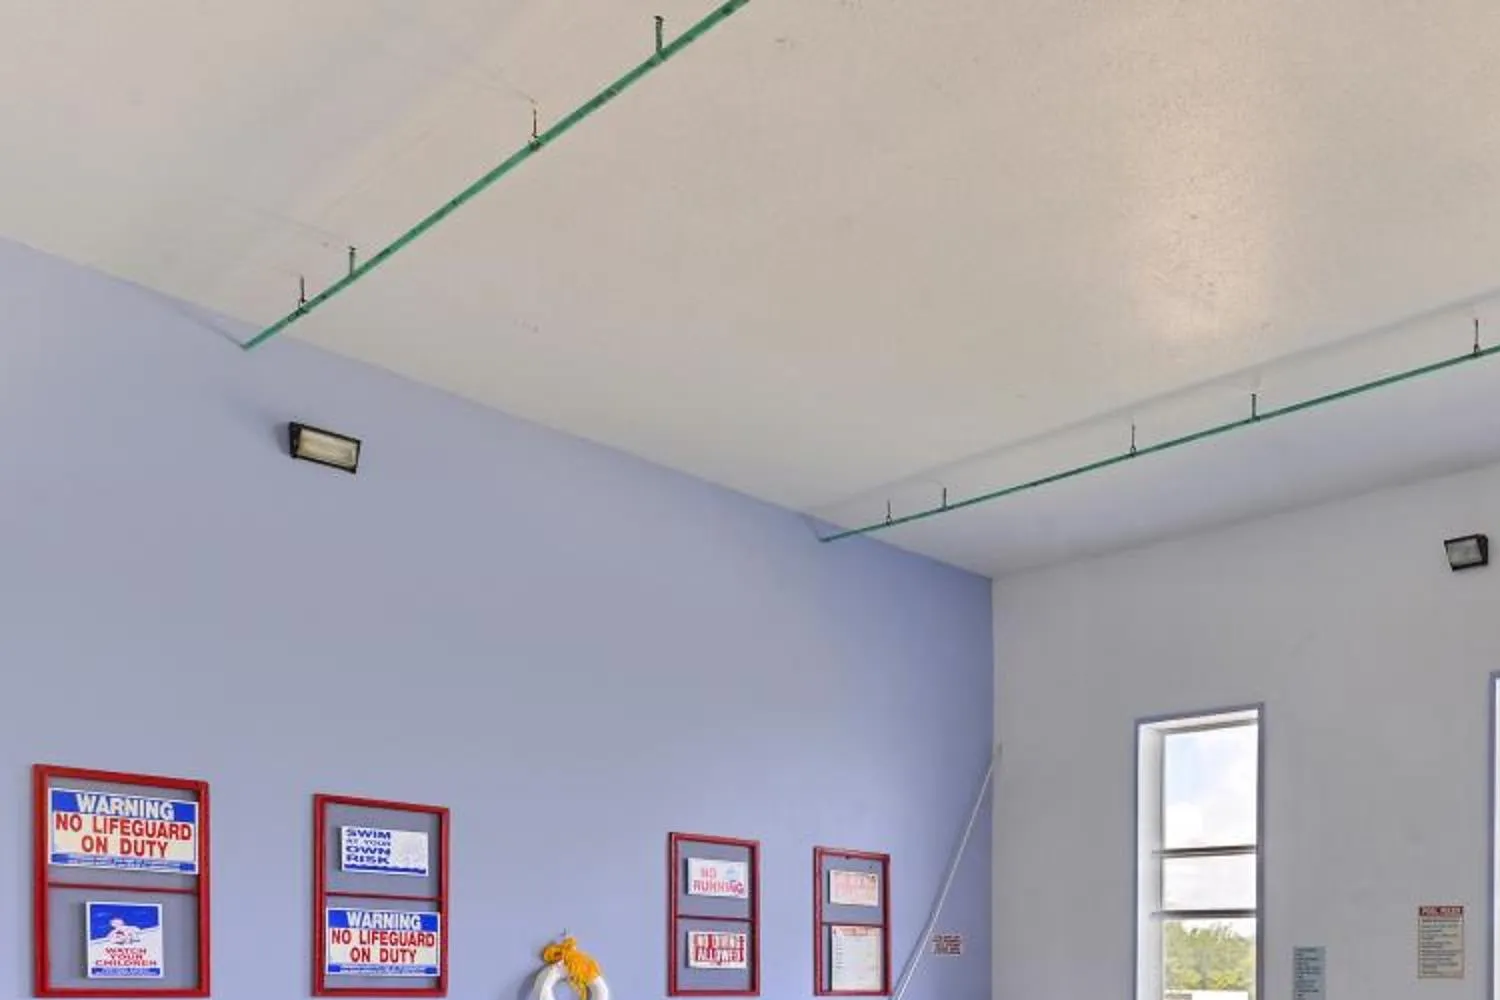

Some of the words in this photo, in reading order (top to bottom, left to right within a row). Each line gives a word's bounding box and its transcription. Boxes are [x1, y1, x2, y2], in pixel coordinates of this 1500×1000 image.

[76, 793, 175, 820] WARNING
[55, 813, 82, 832] NO
[93, 816, 192, 841] LIFEGUARD
[345, 828, 391, 839] SWIM
[81, 835, 108, 854] ON
[120, 838, 168, 858] DUTY
[346, 846, 391, 856] OWN
[346, 854, 391, 865] RISK
[701, 867, 717, 878] NO
[693, 879, 745, 895] RUNNING
[346, 911, 421, 930] WARNING
[331, 929, 352, 945] NO
[360, 930, 435, 947] LIFEGUARD
[350, 946, 371, 962] ON
[379, 948, 417, 963] DUTY
[95, 959, 157, 967] CHILDREN
